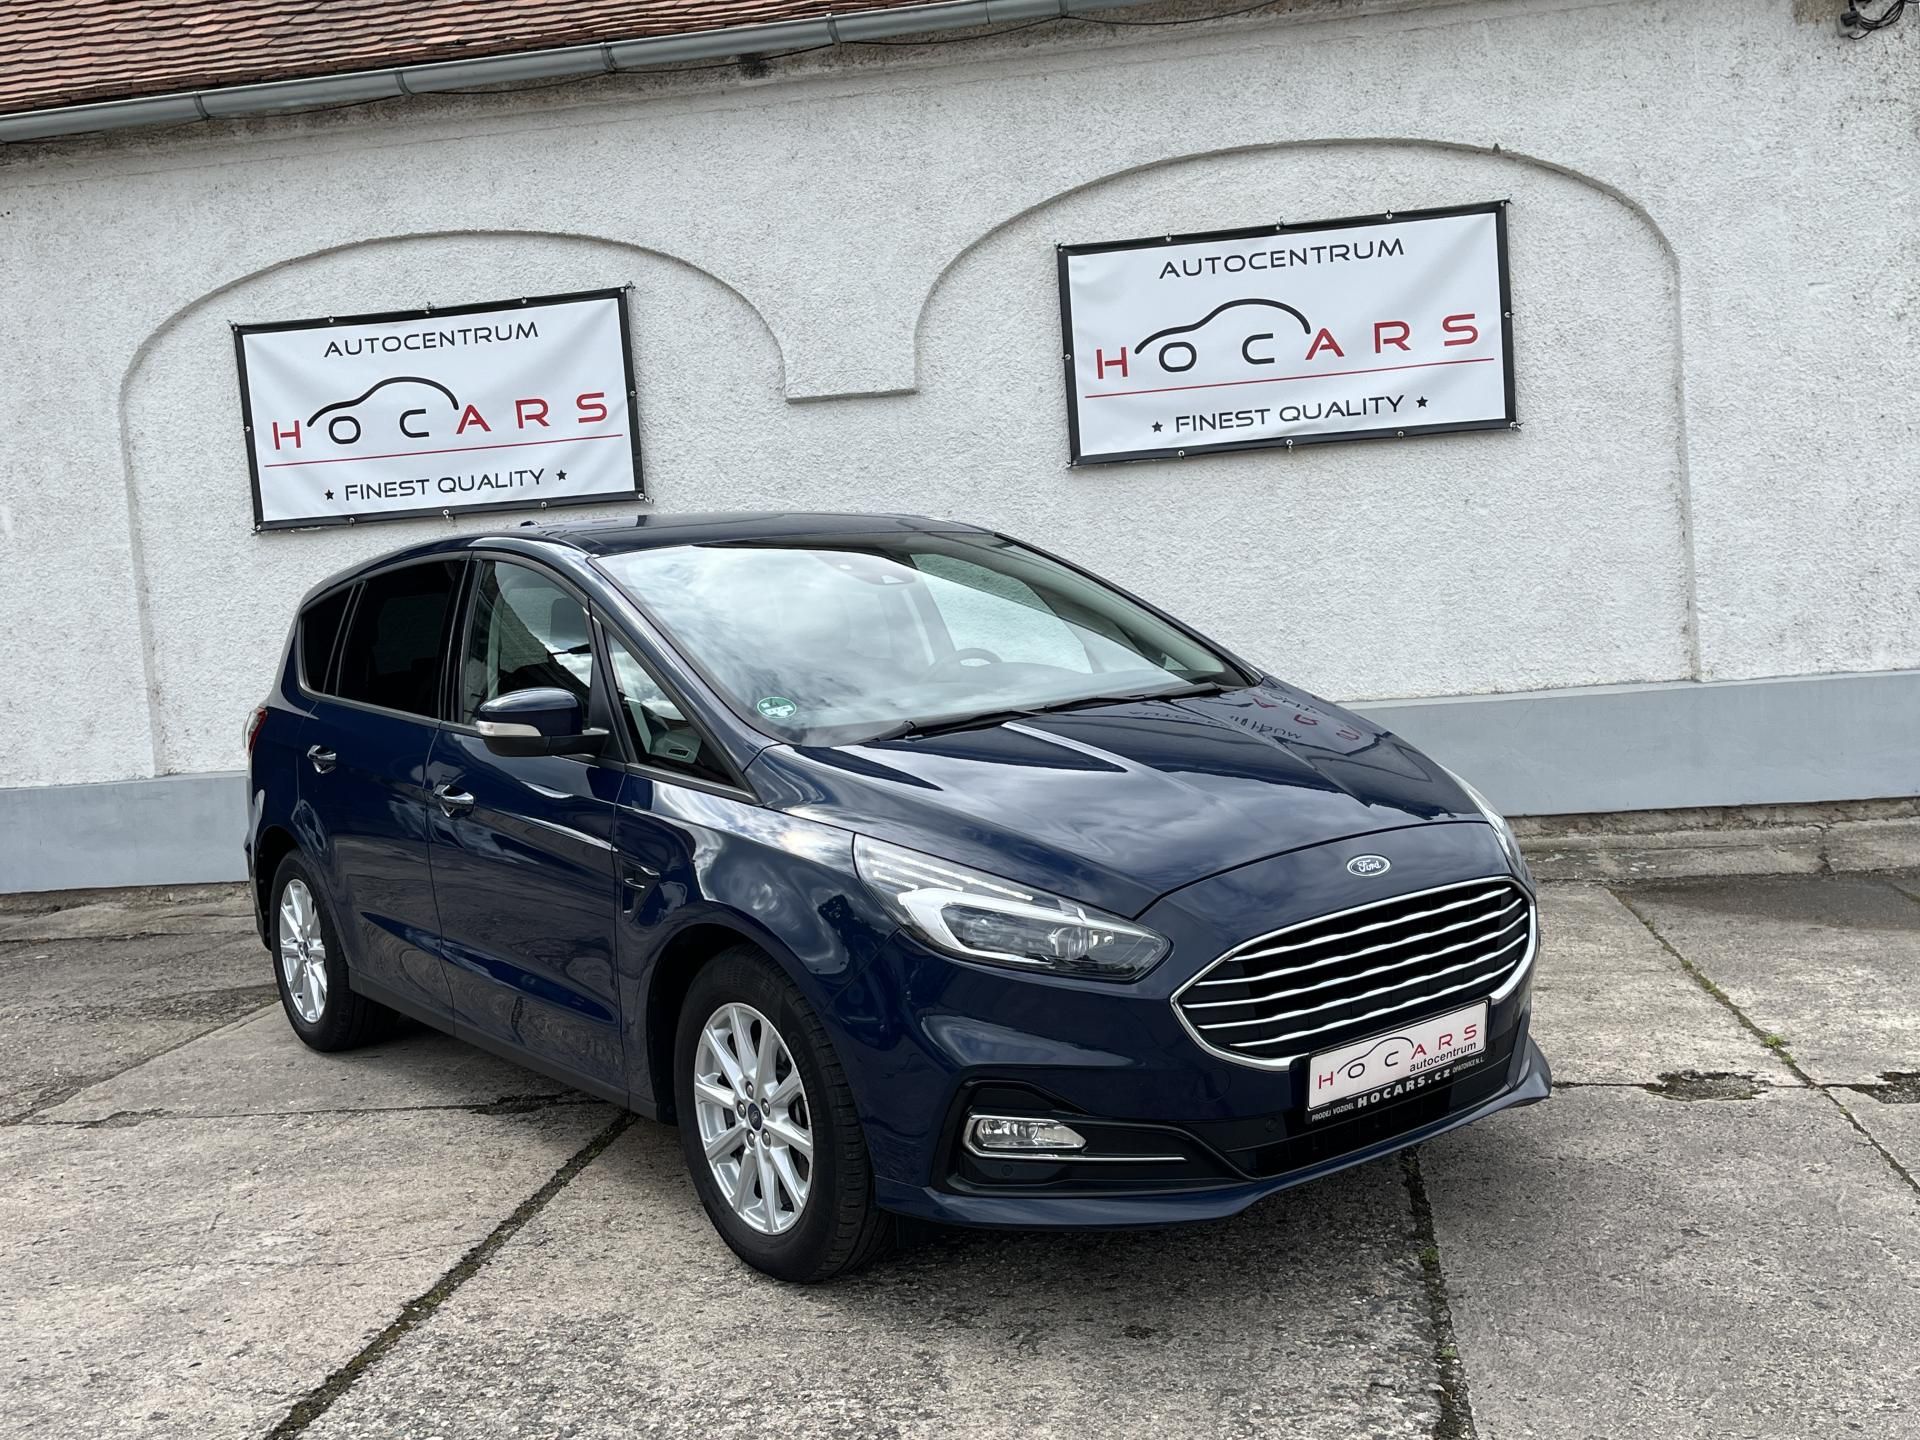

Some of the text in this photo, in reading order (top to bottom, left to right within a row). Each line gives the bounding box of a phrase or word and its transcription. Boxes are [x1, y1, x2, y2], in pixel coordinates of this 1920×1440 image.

[1158, 237, 1405, 279] AUTOCENTRUM
[323, 321, 539, 358] AUTOCENTRUM
[1175, 394, 1405, 433] FINEST QUALITY
[344, 468, 545, 501] FINEST QUALITY
[1357, 859, 1382, 873] Ford
[1409, 1042, 1477, 1073] autocentrum
